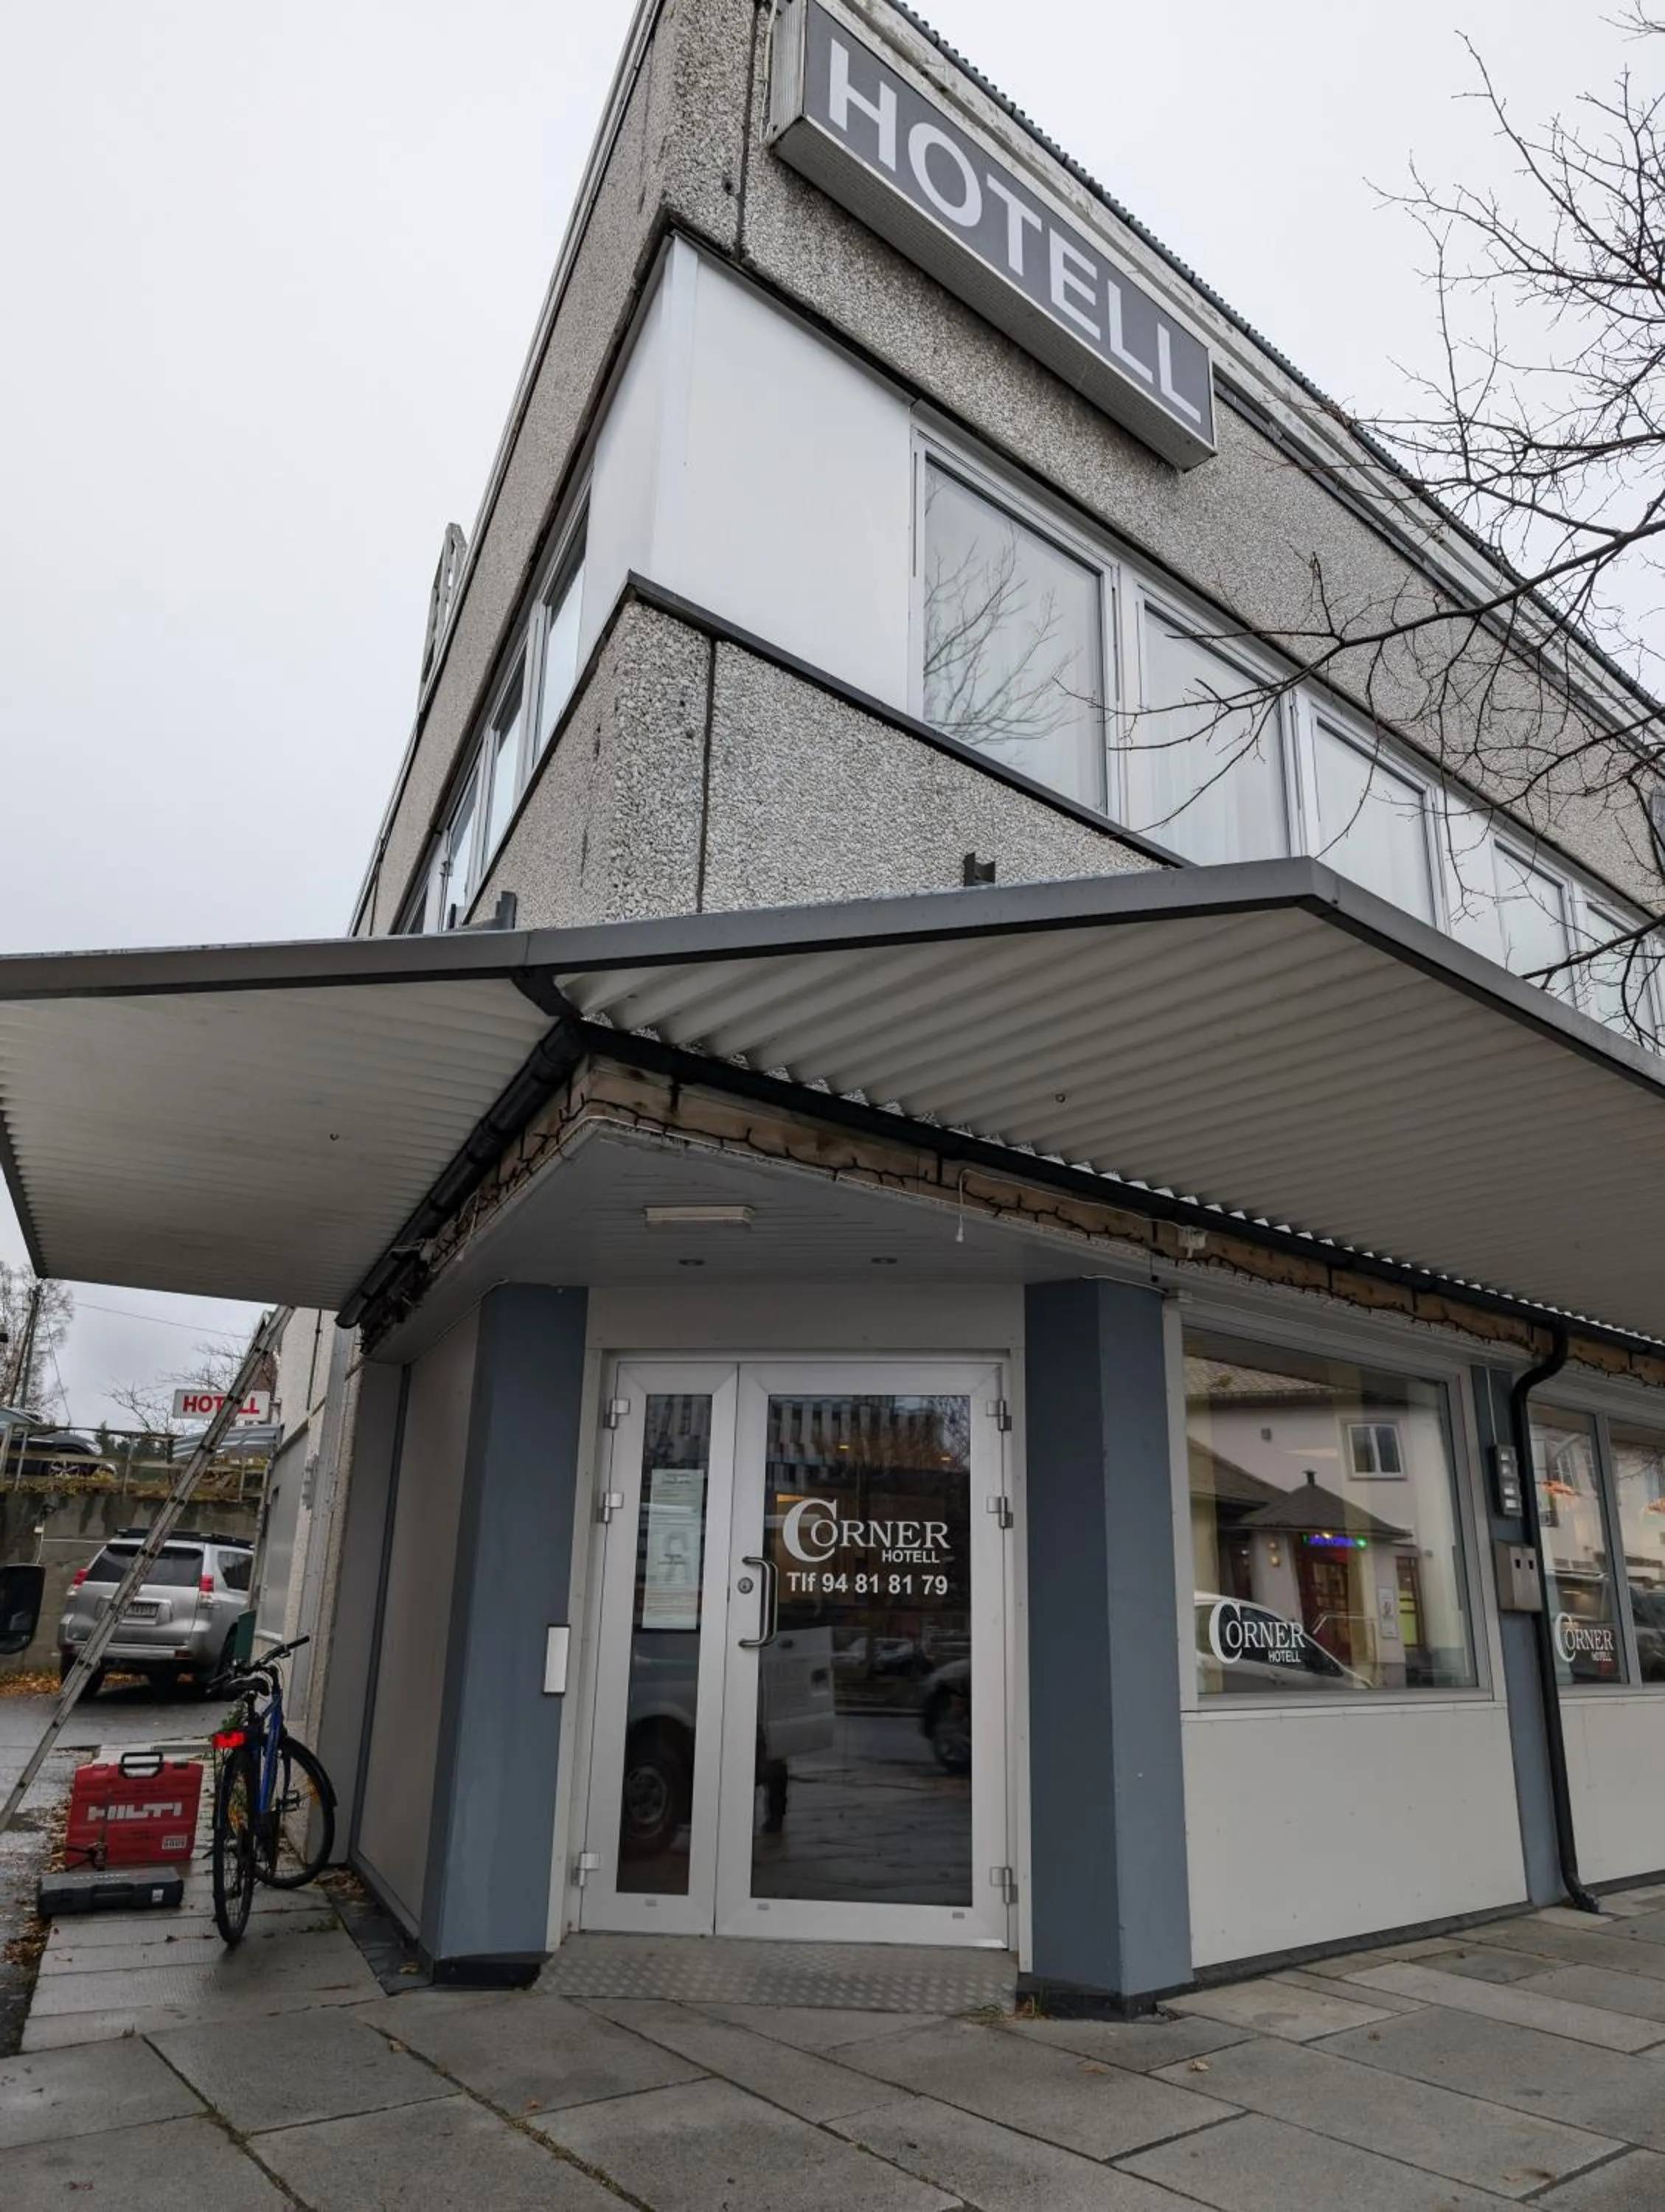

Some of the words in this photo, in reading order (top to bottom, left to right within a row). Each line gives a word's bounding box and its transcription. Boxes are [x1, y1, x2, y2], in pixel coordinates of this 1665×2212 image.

[829, 37, 1201, 424] HOTELL
[182, 1394, 260, 1414] HOTL
[782, 1498, 951, 1562] CORNER
[881, 1549, 940, 1563] HOTELL
[786, 1572, 816, 1592] Tlf
[822, 1573, 848, 1593] 94
[855, 1573, 879, 1593] 81
[888, 1573, 911, 1594] 81
[922, 1574, 948, 1595] 79
[1209, 1600, 1307, 1664] CORNER
[1554, 1612, 1614, 1662] CORNER
[1268, 1649, 1301, 1662] HOTELL
[87, 1802, 182, 1820] HILTI
